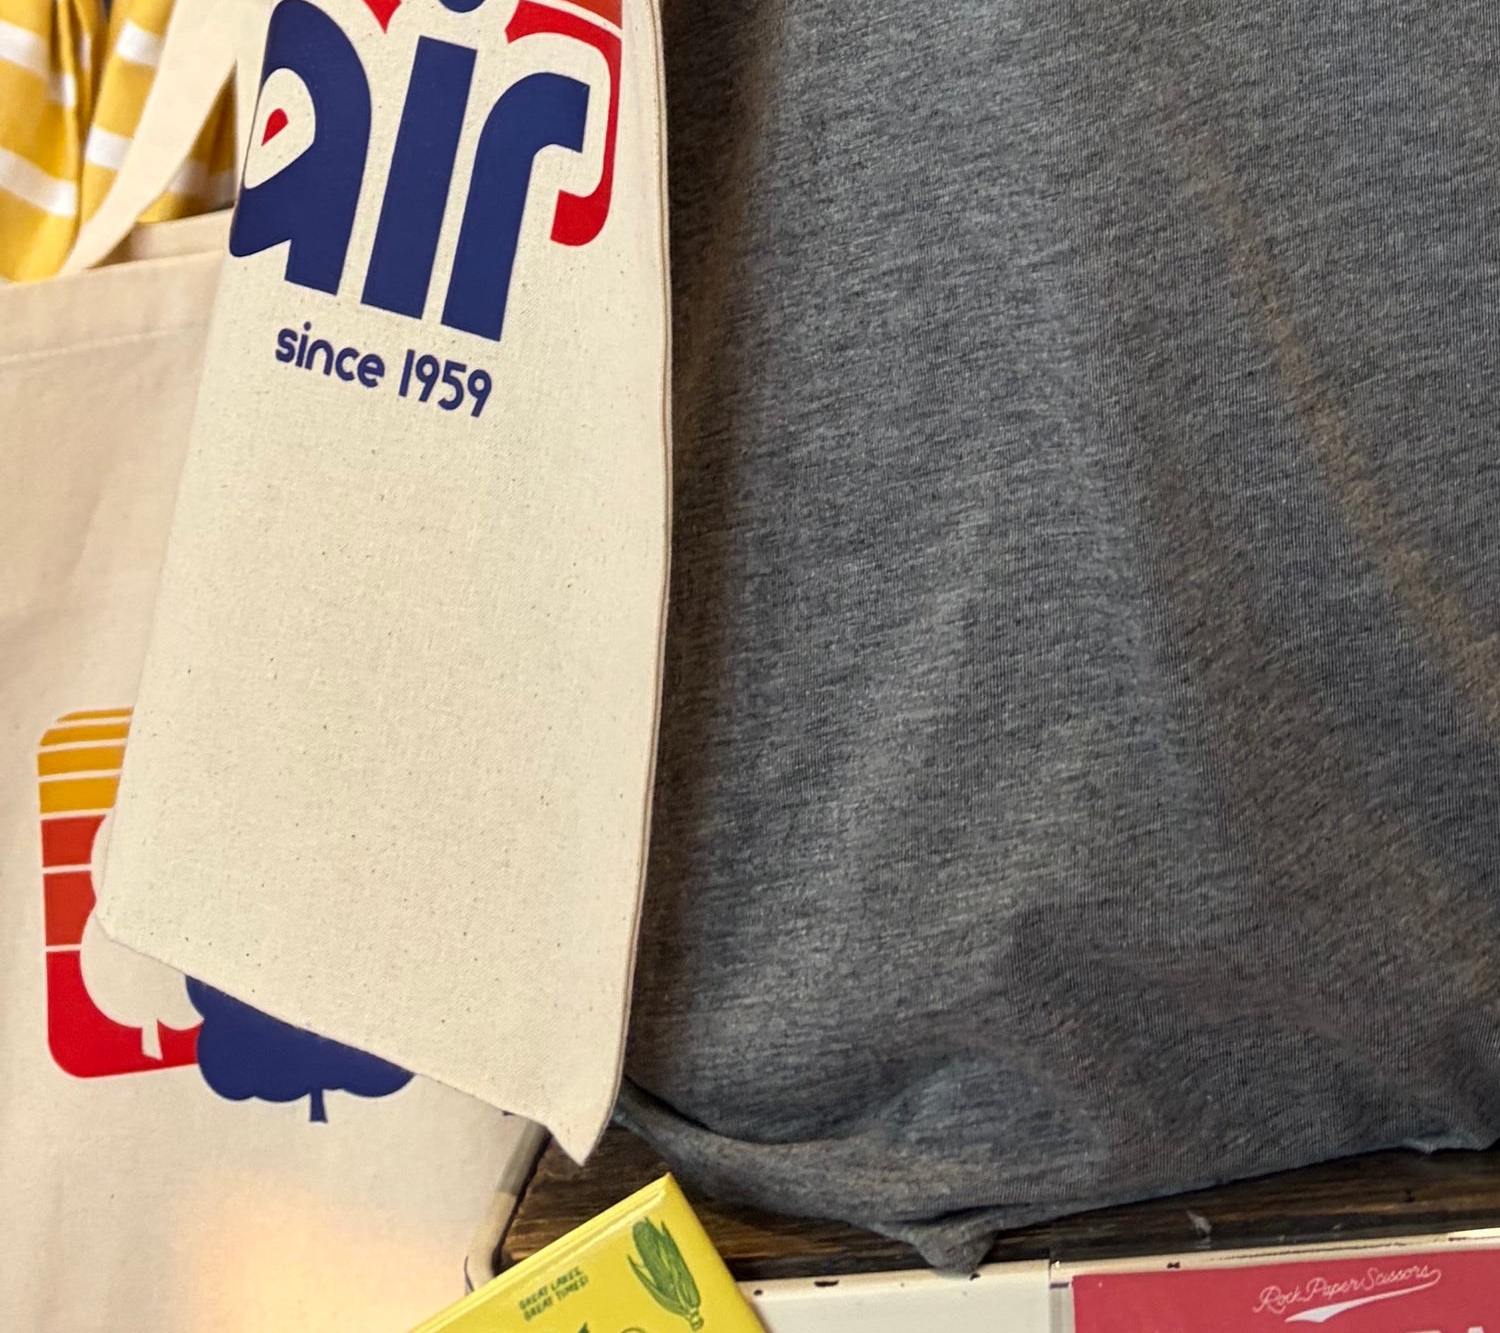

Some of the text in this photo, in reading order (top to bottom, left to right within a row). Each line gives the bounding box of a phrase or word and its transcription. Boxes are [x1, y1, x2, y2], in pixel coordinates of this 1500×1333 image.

[275, 321, 492, 418] since 1959
[520, 1285, 548, 1310] GREAT
[1253, 1265, 1433, 1314] Rock Paper Scissors
[524, 1297, 552, 1321] GREAT
